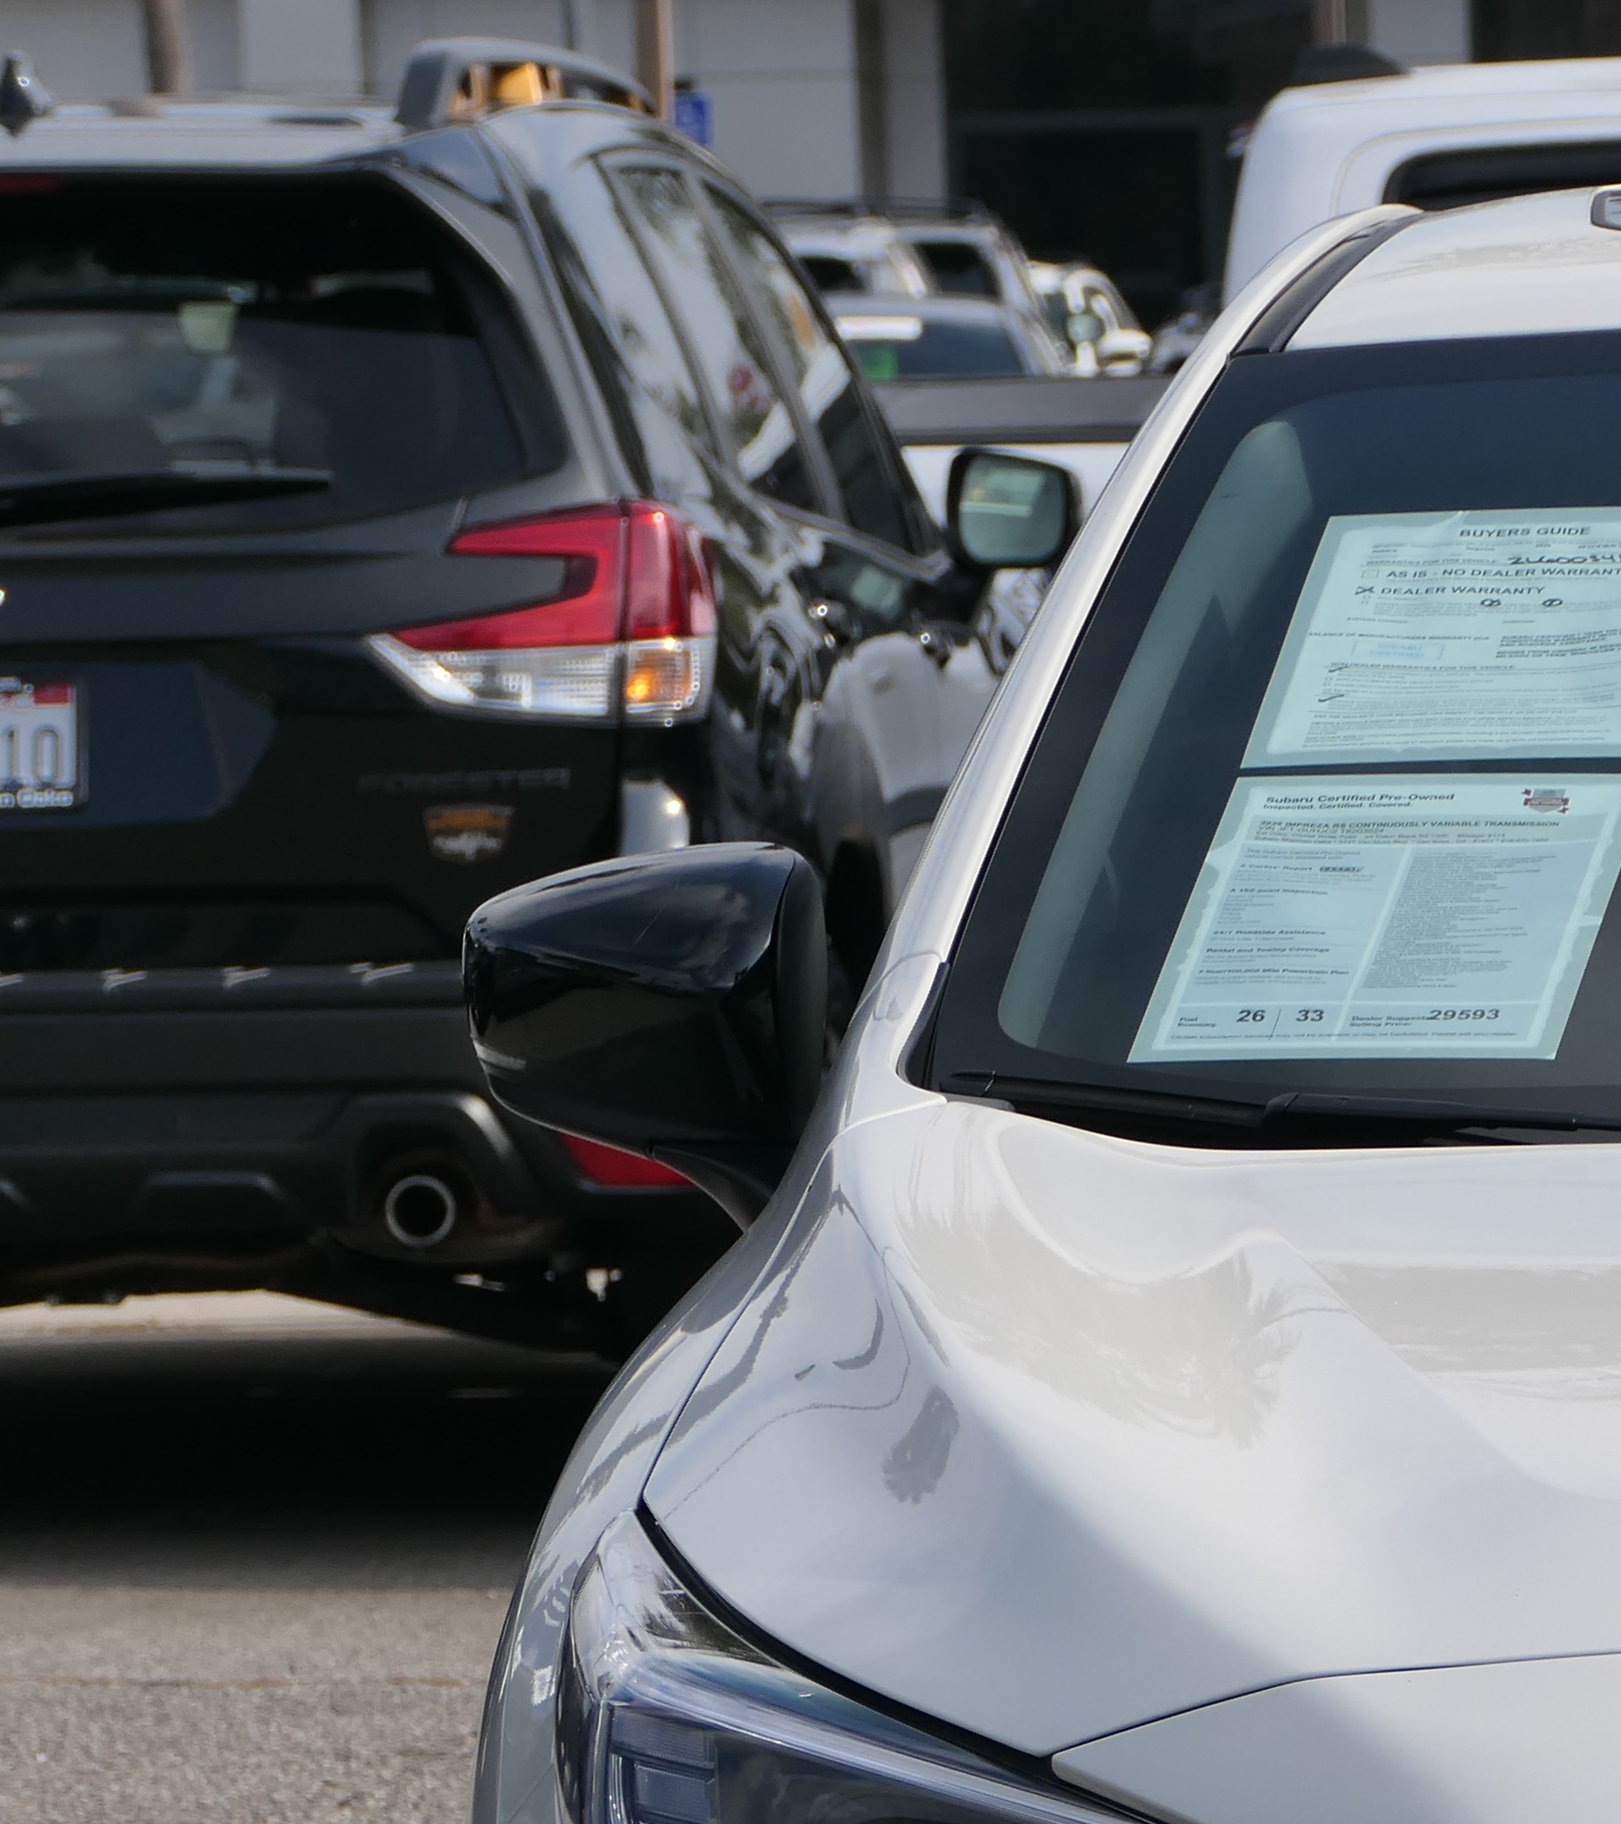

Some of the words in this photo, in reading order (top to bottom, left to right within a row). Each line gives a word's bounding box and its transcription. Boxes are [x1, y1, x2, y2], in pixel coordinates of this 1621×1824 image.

[1459, 526, 1532, 538] BUYERS
[1536, 525, 1591, 536] GUIDE
[1442, 568, 1466, 576] NO
[1470, 568, 1537, 577] DEALER
[1380, 586, 1448, 595] DEALER
[1451, 586, 1546, 596] WARRANTY
[1317, 794, 1376, 802] Certified
[1379, 793, 1455, 801] Pre-Owned
[1236, 1009, 1265, 1022] 26
[1296, 1009, 1324, 1022] 33
[1428, 1008, 1500, 1021] 29593
